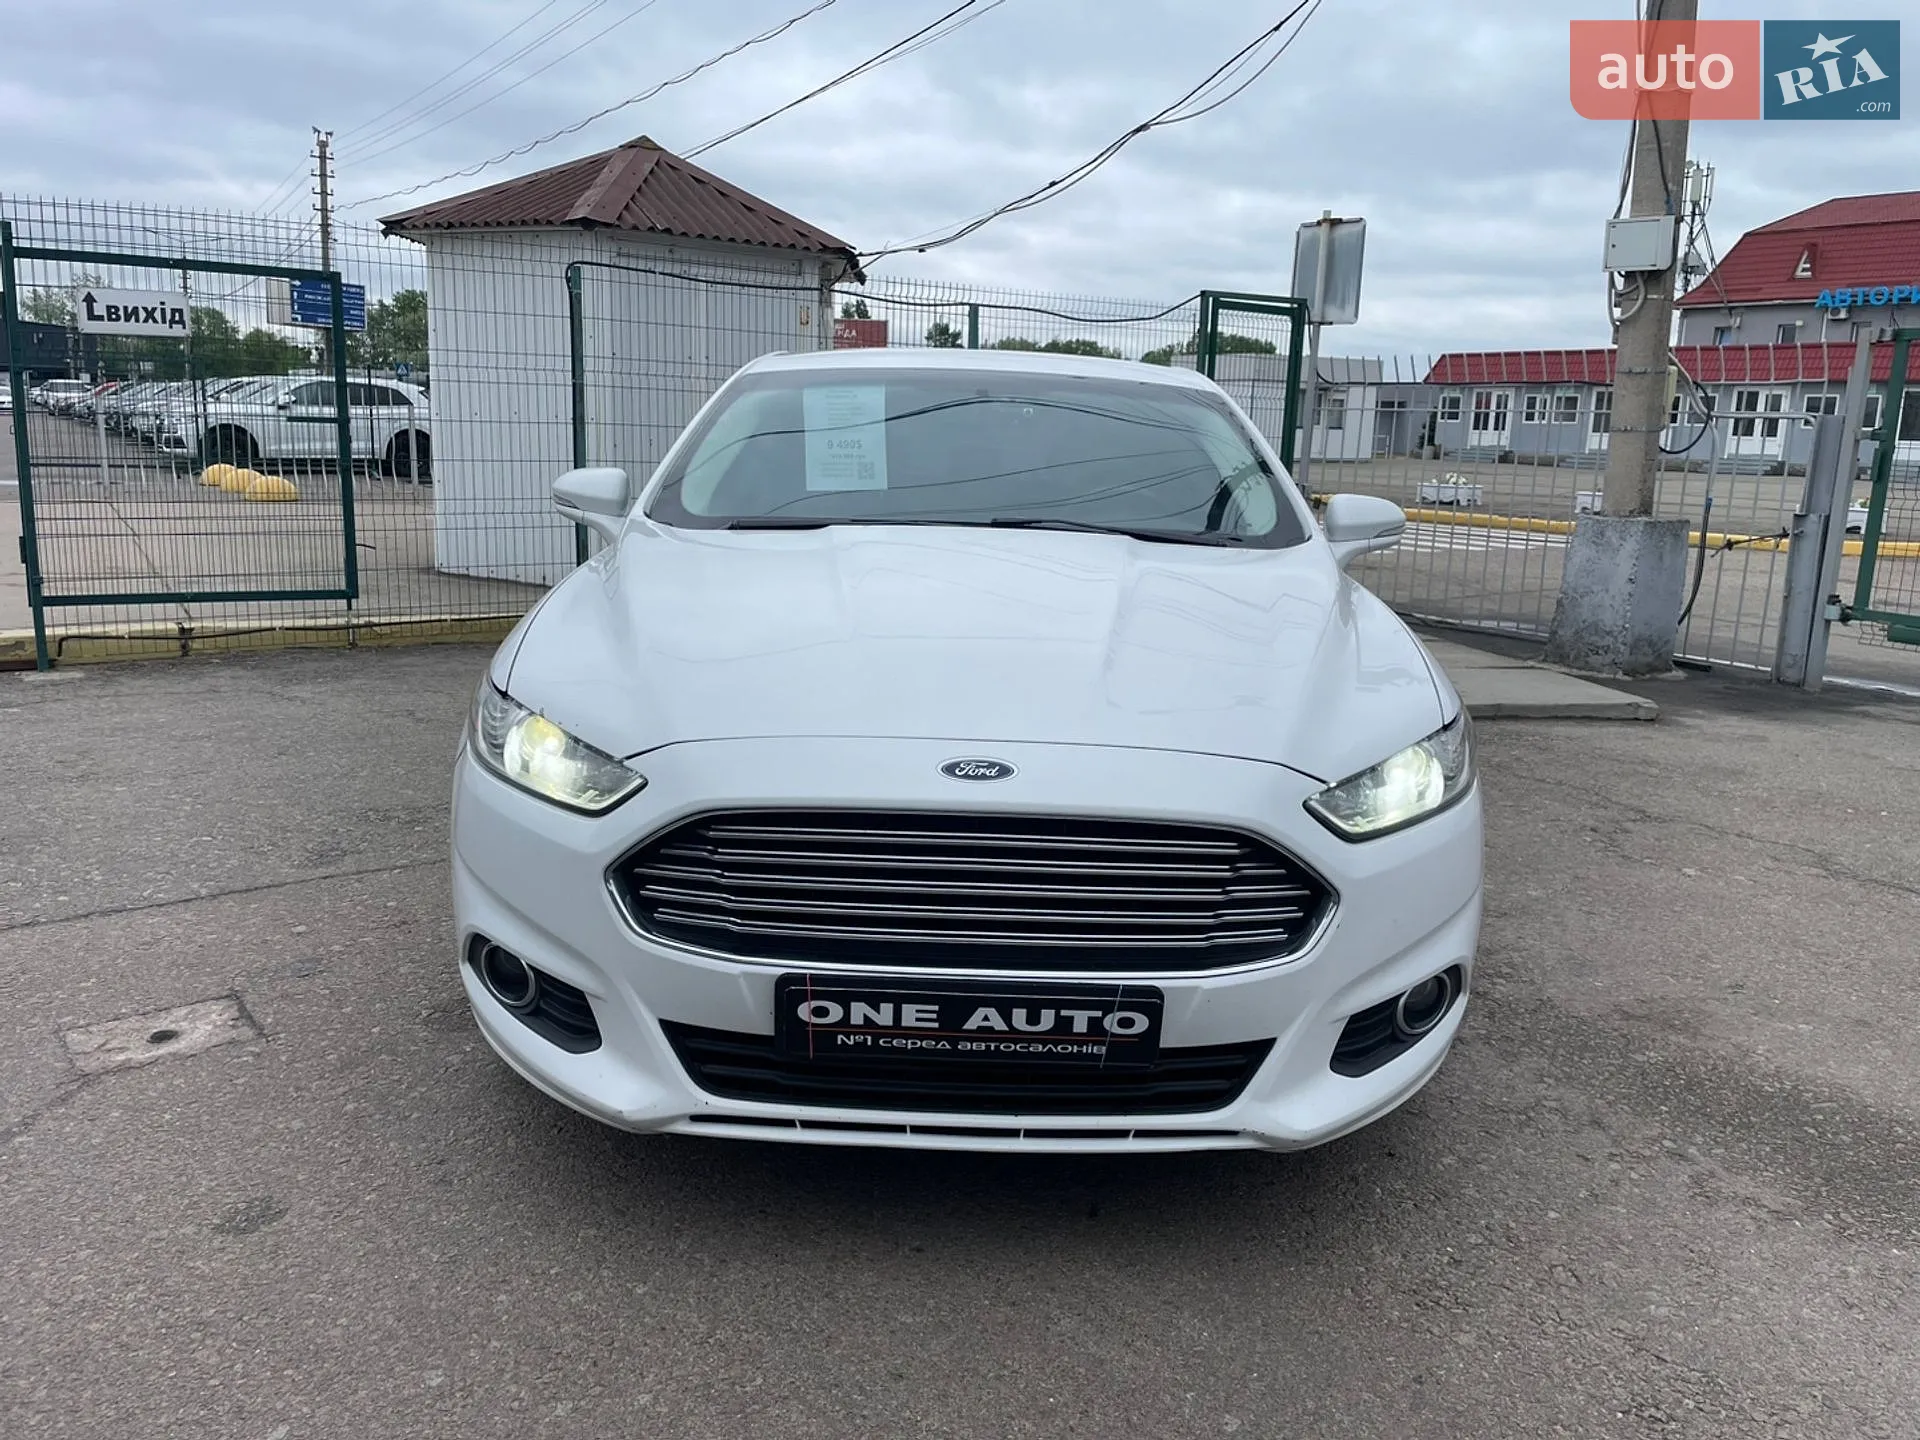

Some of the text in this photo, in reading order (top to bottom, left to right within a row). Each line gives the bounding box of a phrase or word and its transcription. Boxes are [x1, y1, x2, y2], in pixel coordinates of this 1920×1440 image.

[105, 301, 187, 330] вихід
[955, 761, 1000, 777] Ford
[797, 1000, 1149, 1035] ONE AUTO
[879, 1037, 952, 1050] серед
[957, 1041, 1106, 1054] автосалонів
